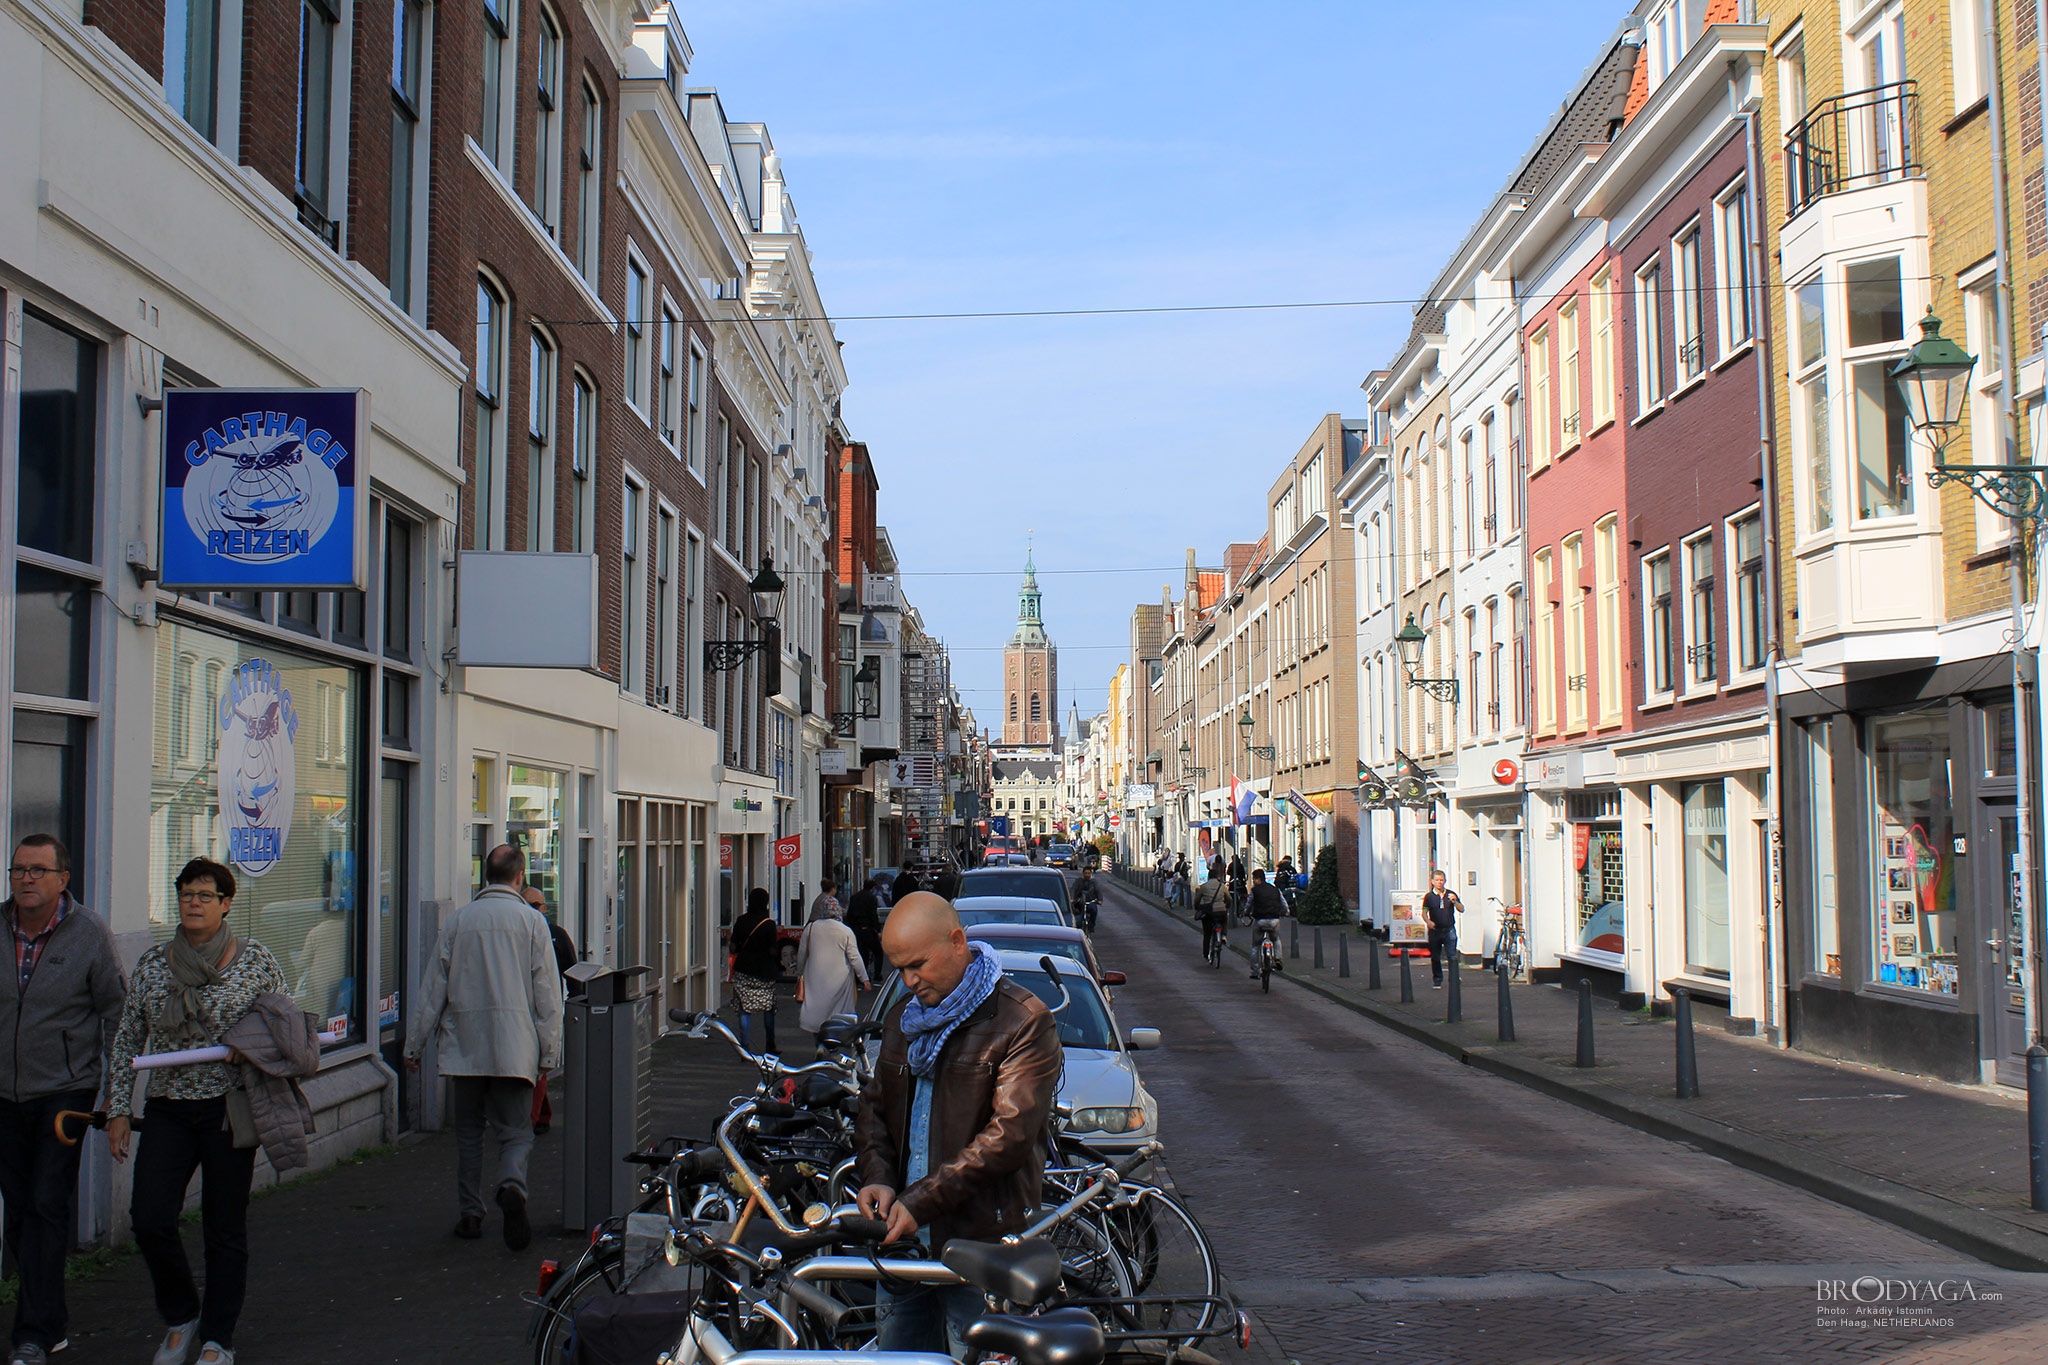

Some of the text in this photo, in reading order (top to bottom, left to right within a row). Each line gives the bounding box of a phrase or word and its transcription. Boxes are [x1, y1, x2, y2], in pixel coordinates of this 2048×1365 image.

[185, 411, 349, 470] CARTHAGE
[206, 529, 310, 555] REIZEN
[220, 658, 300, 744] CARTHAGE
[996, 821, 1002, 830] P
[229, 827, 282, 864] REIZEN
[1953, 837, 1967, 854] 128
